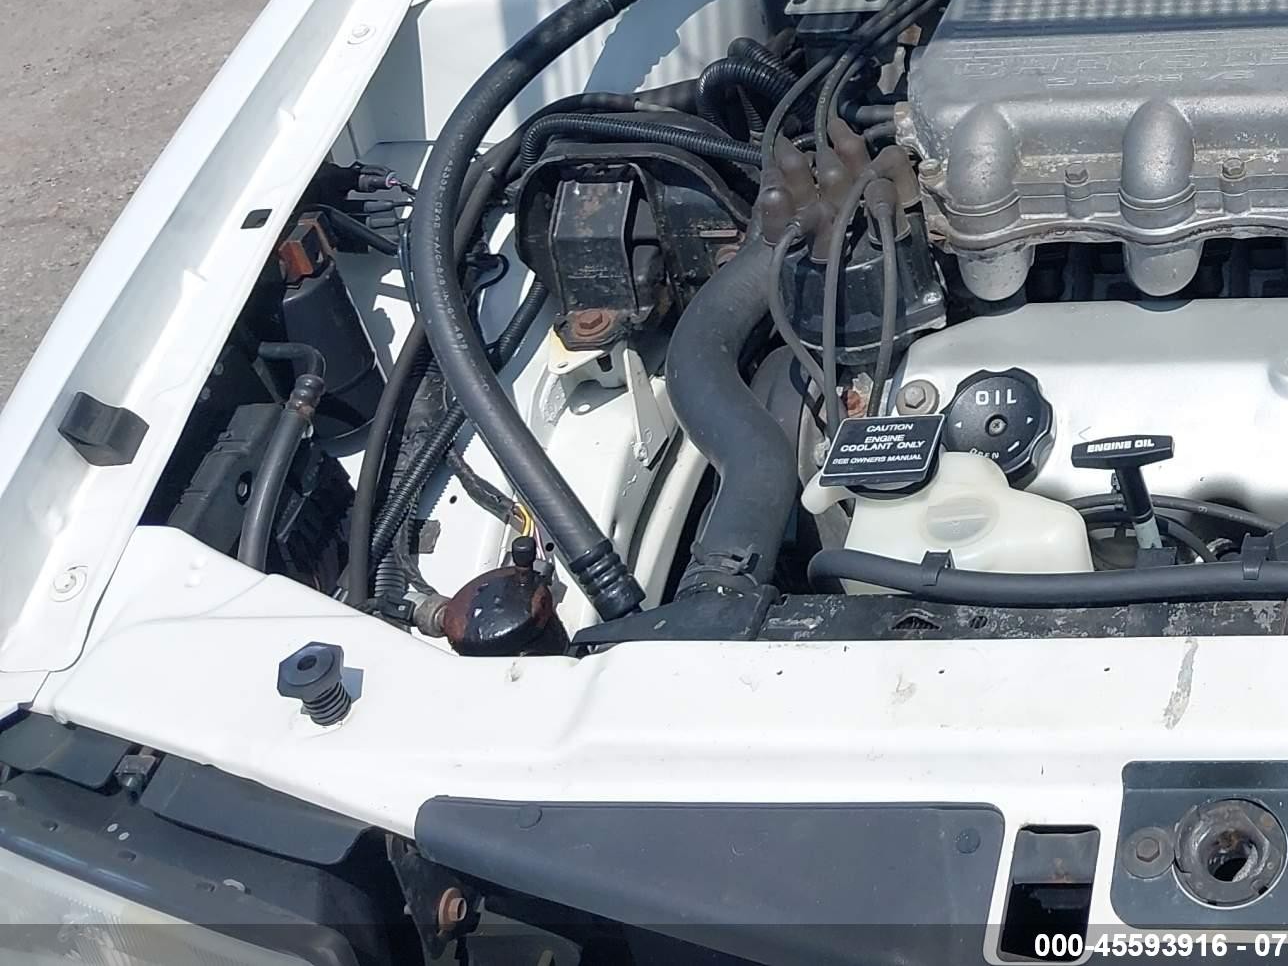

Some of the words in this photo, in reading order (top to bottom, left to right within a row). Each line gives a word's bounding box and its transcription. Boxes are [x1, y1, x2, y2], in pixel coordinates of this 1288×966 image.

[975, 389, 1017, 405] OIL
[866, 423, 914, 433] CAUTION
[864, 434, 905, 444] ENGINE
[840, 442, 893, 452] COOLANT
[897, 441, 926, 450] ONLY
[1087, 440, 1132, 453] ENGINE
[1135, 439, 1155, 449] OIL
[850, 456, 887, 465] OWNERS
[887, 454, 922, 463] MANUAL
